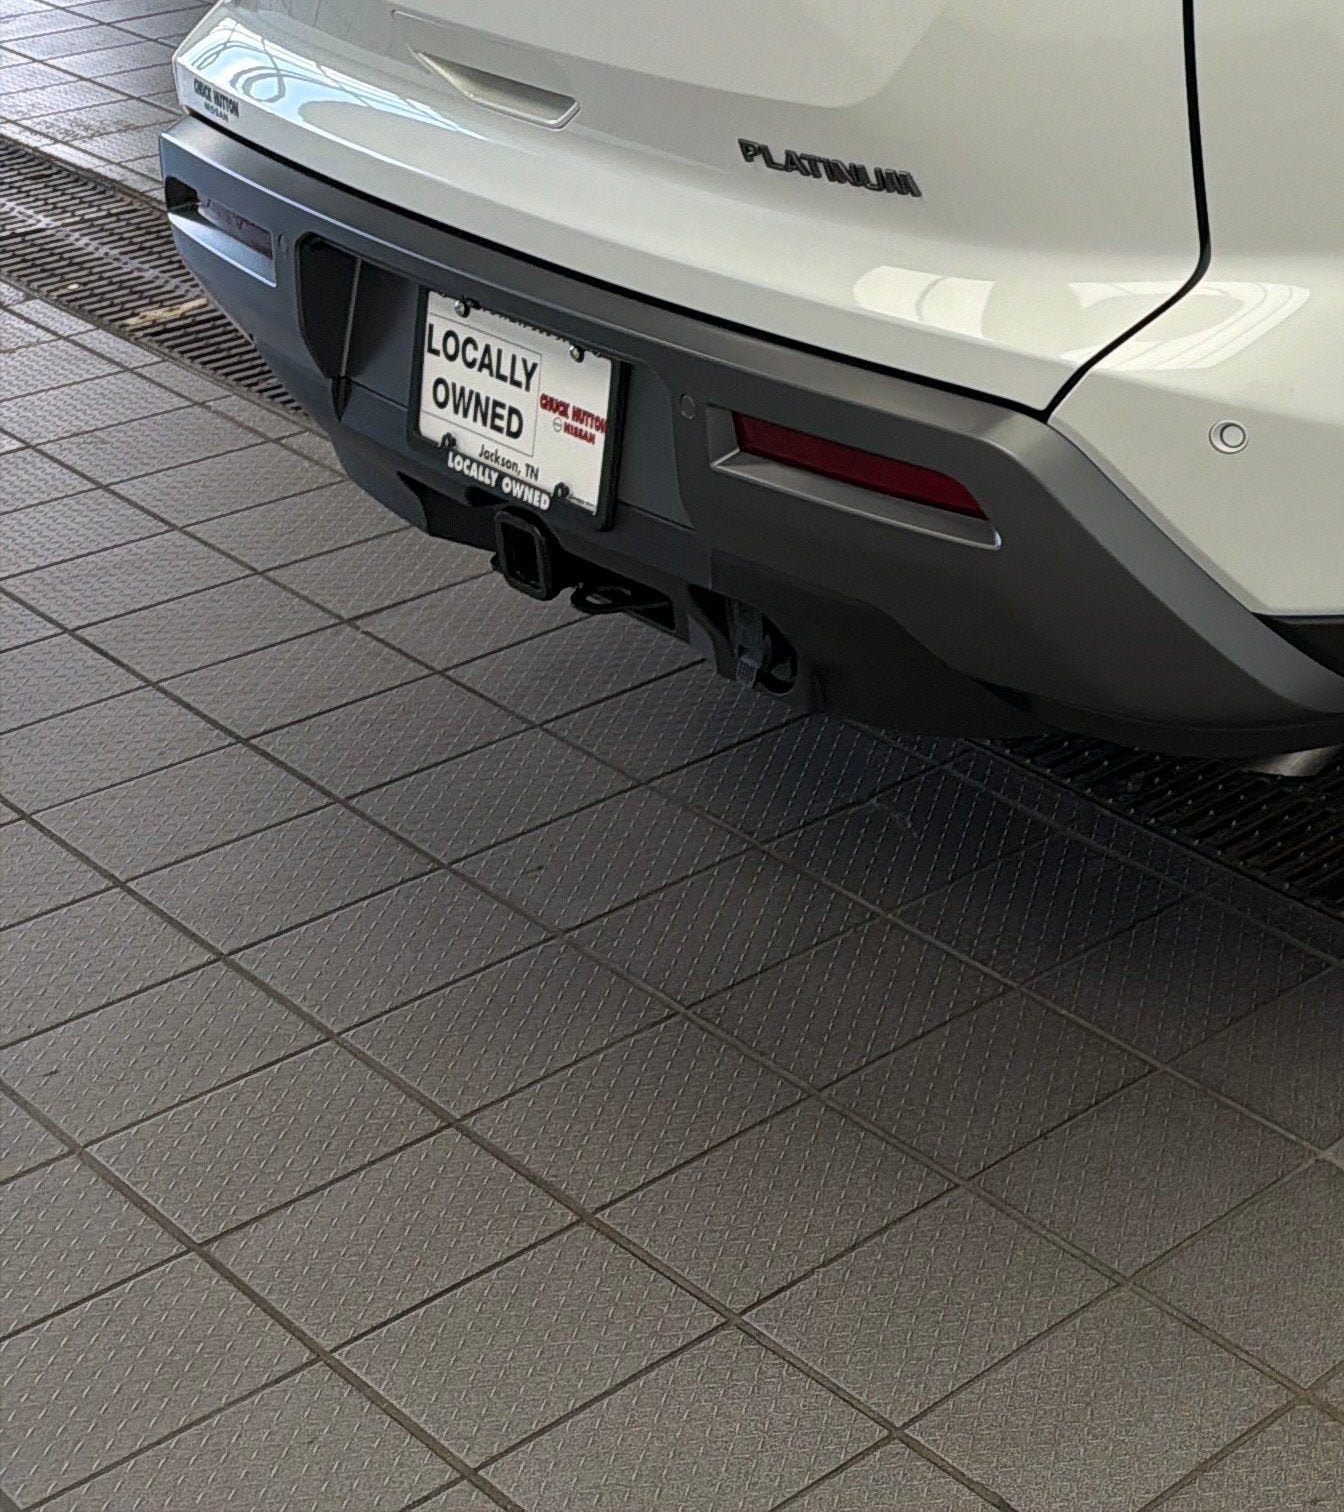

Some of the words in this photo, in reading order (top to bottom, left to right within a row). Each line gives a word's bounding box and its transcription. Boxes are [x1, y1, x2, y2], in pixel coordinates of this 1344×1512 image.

[738, 138, 922, 198] PLATINUM
[427, 323, 538, 392] LOCALLY
[432, 377, 524, 439] OWNED
[540, 392, 570, 420] CHUCK
[571, 405, 608, 434] HUTTON
[447, 451, 498, 487] LOCALLY
[502, 476, 550, 511] OWNED
[478, 444, 522, 476] Jackson,
[525, 463, 539, 481] TN
